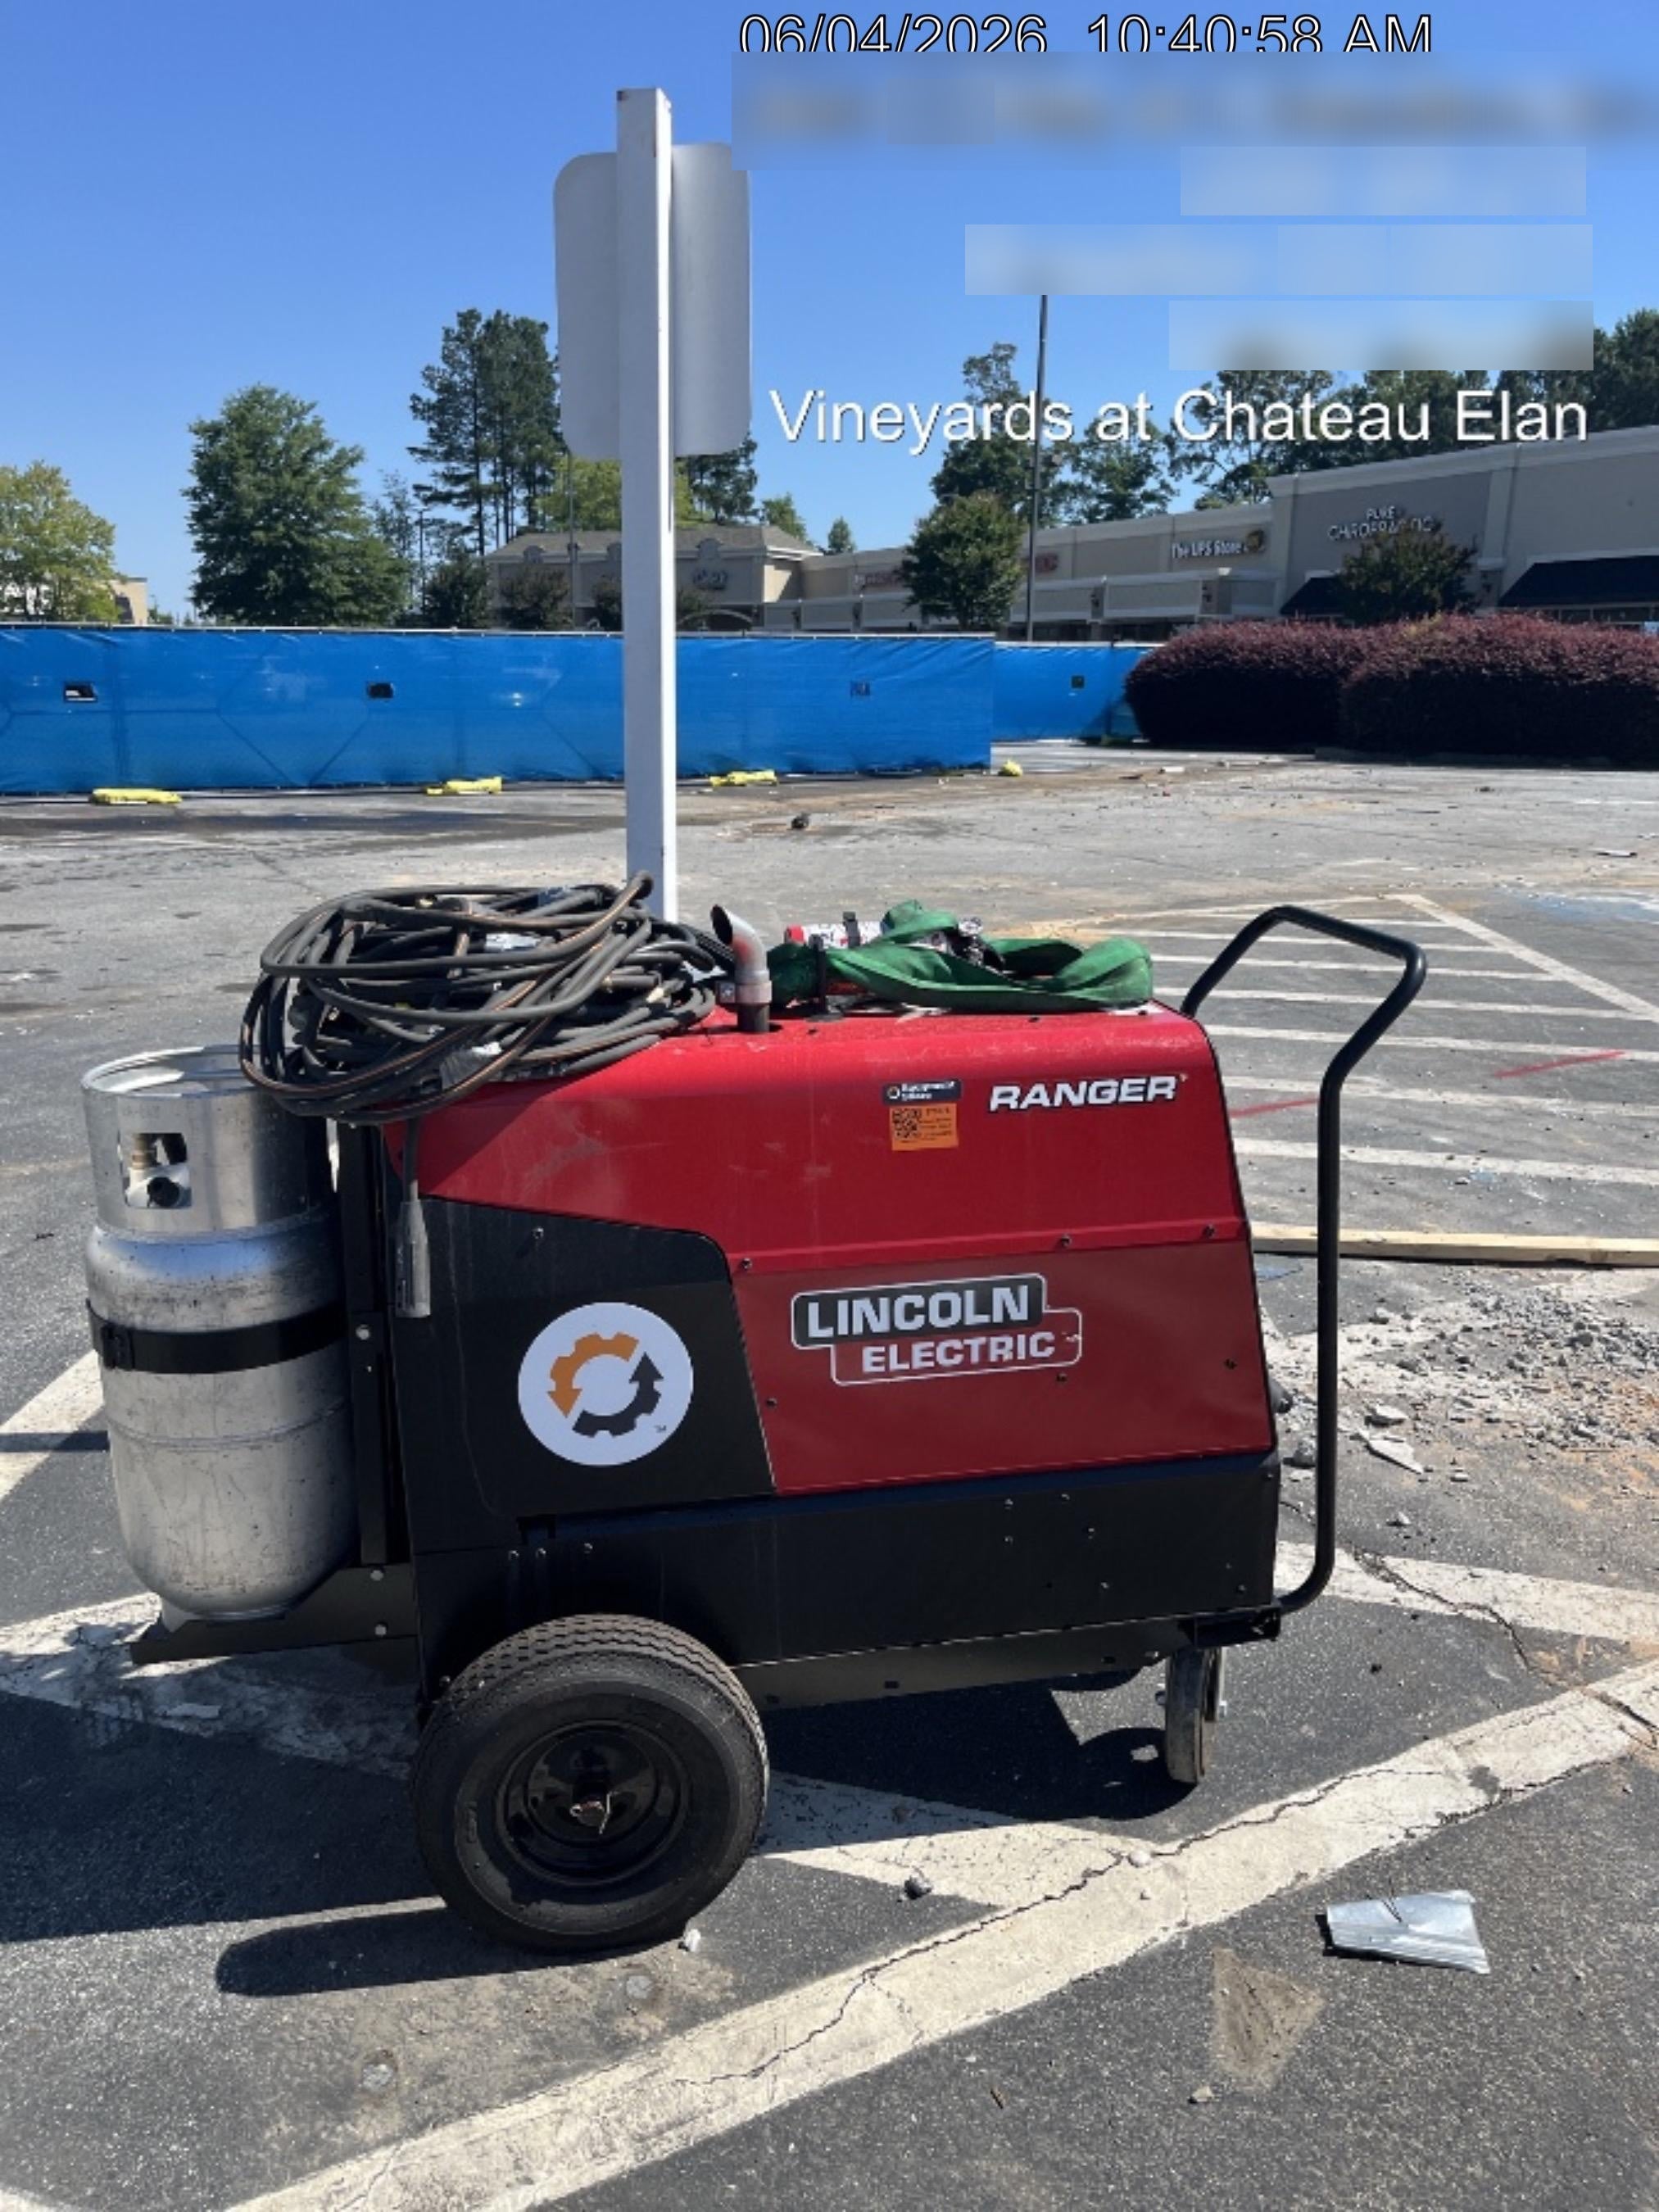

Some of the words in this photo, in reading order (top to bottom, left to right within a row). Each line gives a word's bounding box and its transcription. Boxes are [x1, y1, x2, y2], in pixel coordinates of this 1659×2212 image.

[989, 1076, 1177, 1112] RANGER
[807, 1285, 1029, 1339] LINCOLN
[861, 1330, 1056, 1374] ELECTRIC
